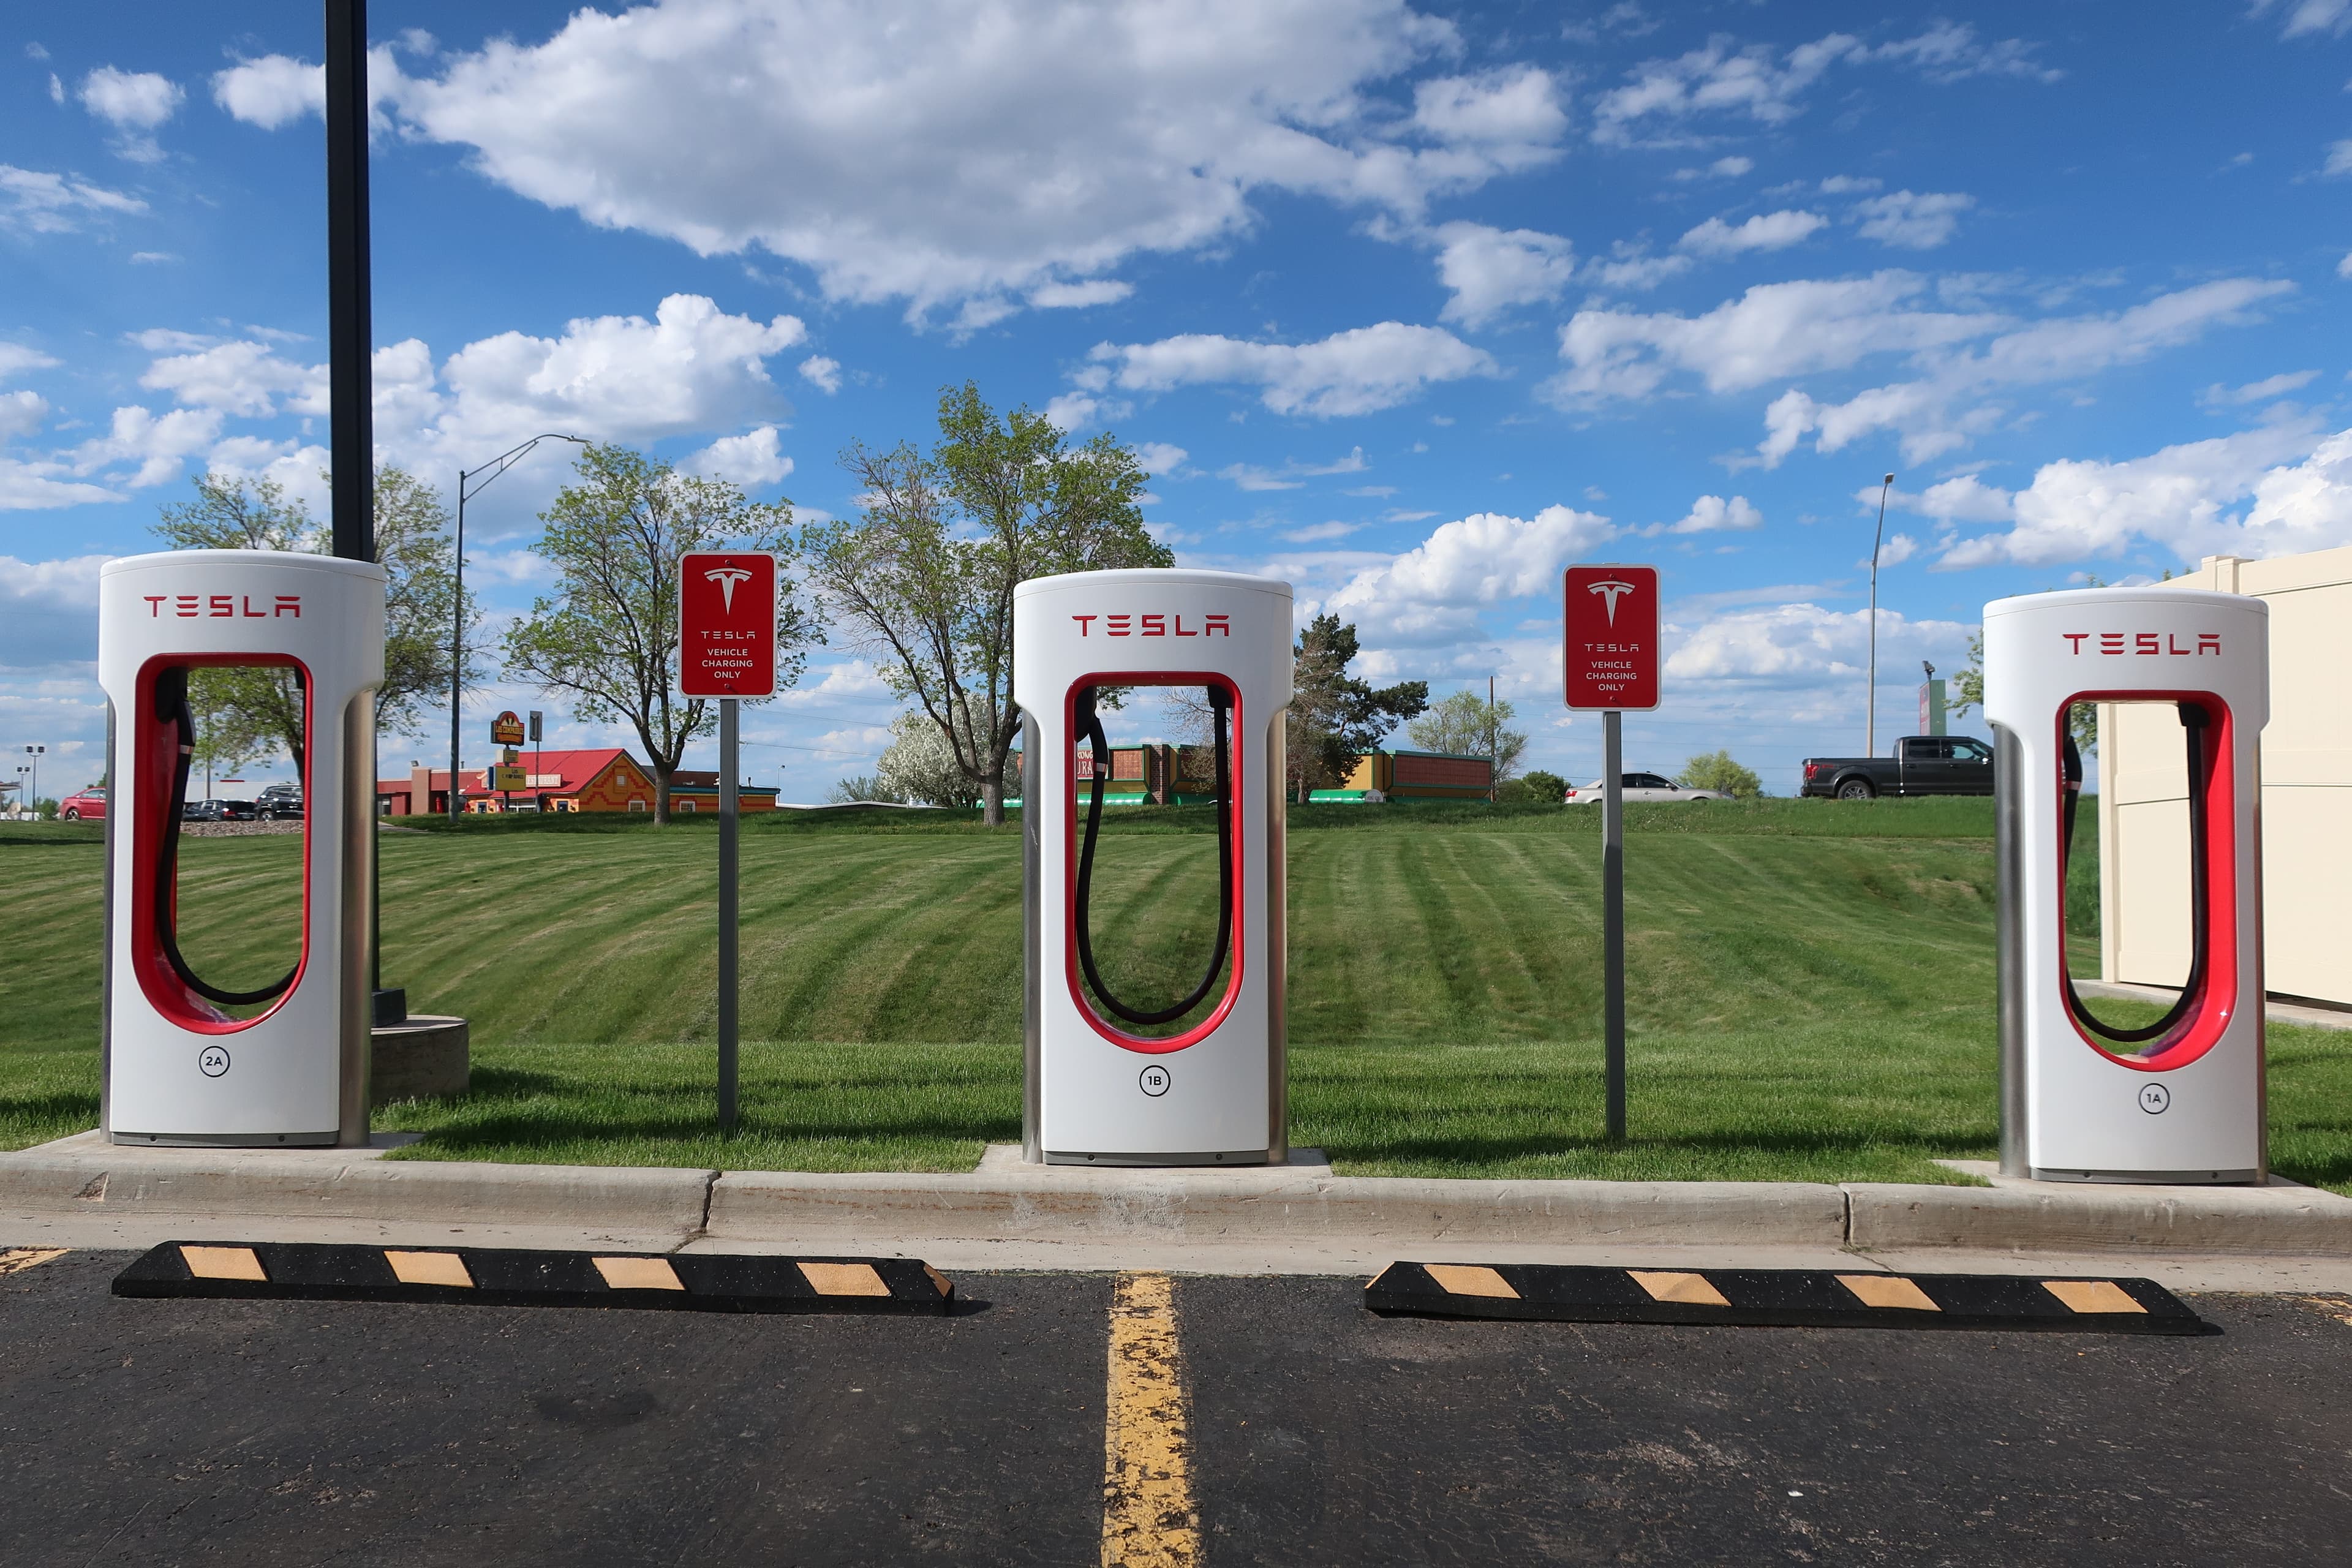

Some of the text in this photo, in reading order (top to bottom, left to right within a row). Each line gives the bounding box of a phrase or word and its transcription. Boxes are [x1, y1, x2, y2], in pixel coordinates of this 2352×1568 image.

[143, 595, 301, 617] TESLA
[1072, 614, 1230, 637] TESLA
[701, 631, 755, 639] TESLA
[2062, 633, 2220, 655] TESLA
[205, 1056, 222, 1066] 2A
[1148, 1076, 1162, 1085] 1B
[2147, 1093, 2162, 1103] 1A
